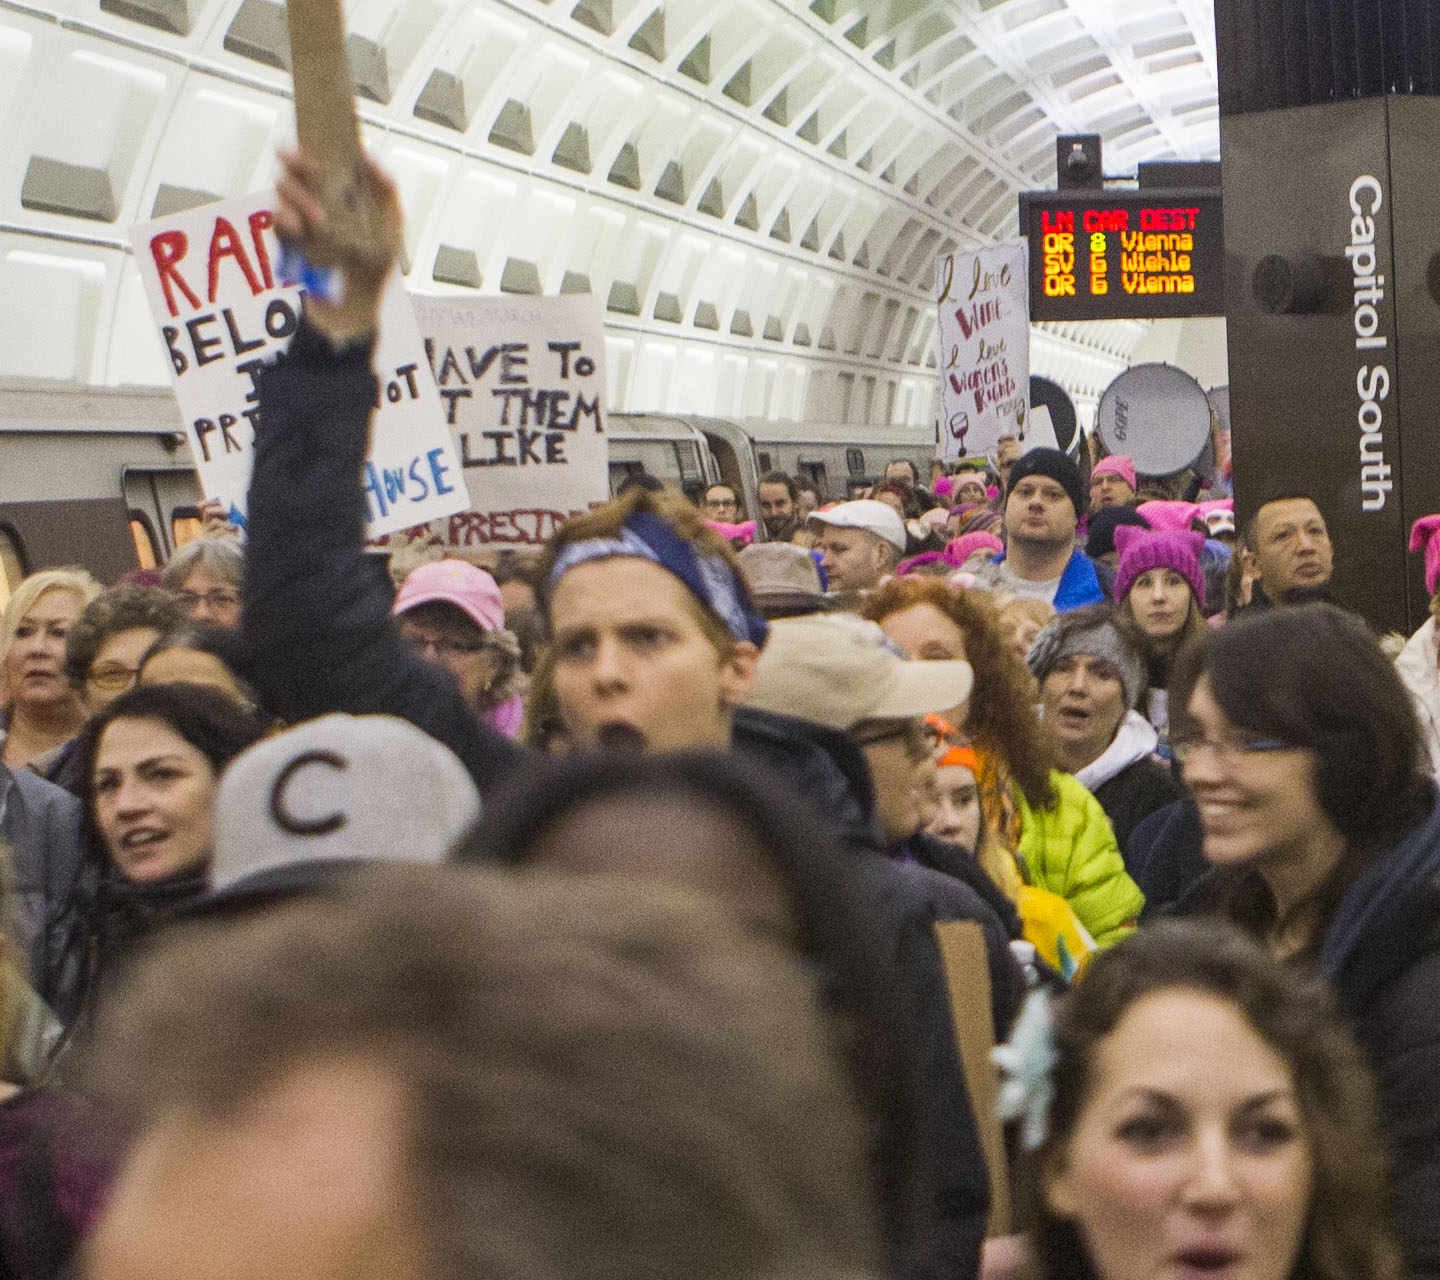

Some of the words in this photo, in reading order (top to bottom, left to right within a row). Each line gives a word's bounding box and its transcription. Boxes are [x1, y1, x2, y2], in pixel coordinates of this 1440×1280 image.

[1041, 209, 1075, 233] LN
[1083, 209, 1129, 233] CAR
[1139, 207, 1201, 231] DEST
[149, 209, 300, 318] RAP
[1042, 232, 1075, 254] OR
[1089, 231, 1107, 253] 8
[1120, 231, 1194, 252] Vienna
[1043, 252, 1076, 275] SV
[1089, 252, 1108, 273] 6
[1120, 251, 1192, 273] Wiehle
[1345, 174, 1388, 350] Capitol
[968, 256, 1011, 301] love
[1043, 274, 1077, 297] OR
[1089, 272, 1109, 295] 6
[1121, 273, 1195, 294] Vienna
[976, 338, 1008, 365] love
[491, 387, 604, 433] THEM
[459, 428, 569, 469] LIKE
[1357, 365, 1394, 512] South
[271, 749, 348, 836] C
